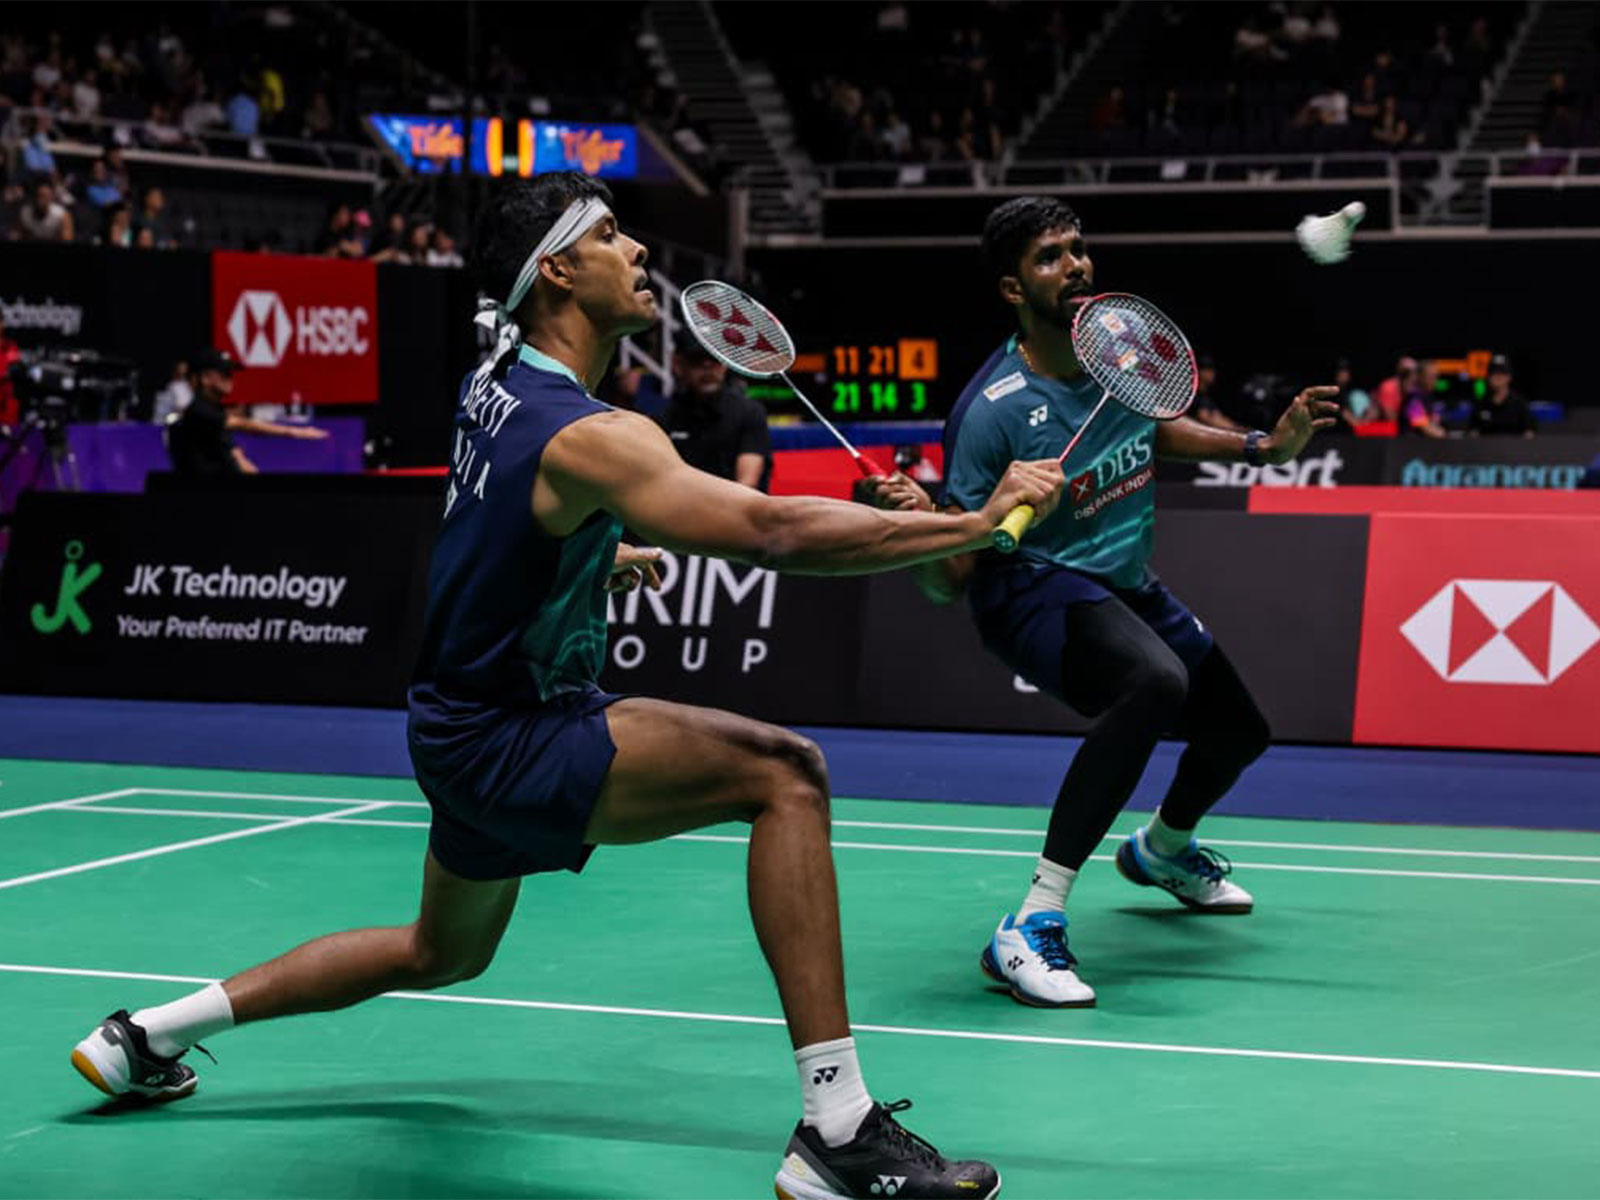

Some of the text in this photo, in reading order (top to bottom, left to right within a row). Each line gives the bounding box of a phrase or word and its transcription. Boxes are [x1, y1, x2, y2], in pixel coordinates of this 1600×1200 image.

[296, 306, 369, 356] HSBC
[834, 346, 860, 375] 11
[868, 345, 896, 375] 21
[832, 381, 860, 412] 21
[1097, 430, 1152, 489] DBS
[124, 564, 347, 608] JK Technology
[117, 614, 368, 645] Your Preferred IT Partner
[613, 635, 768, 673] OUP
